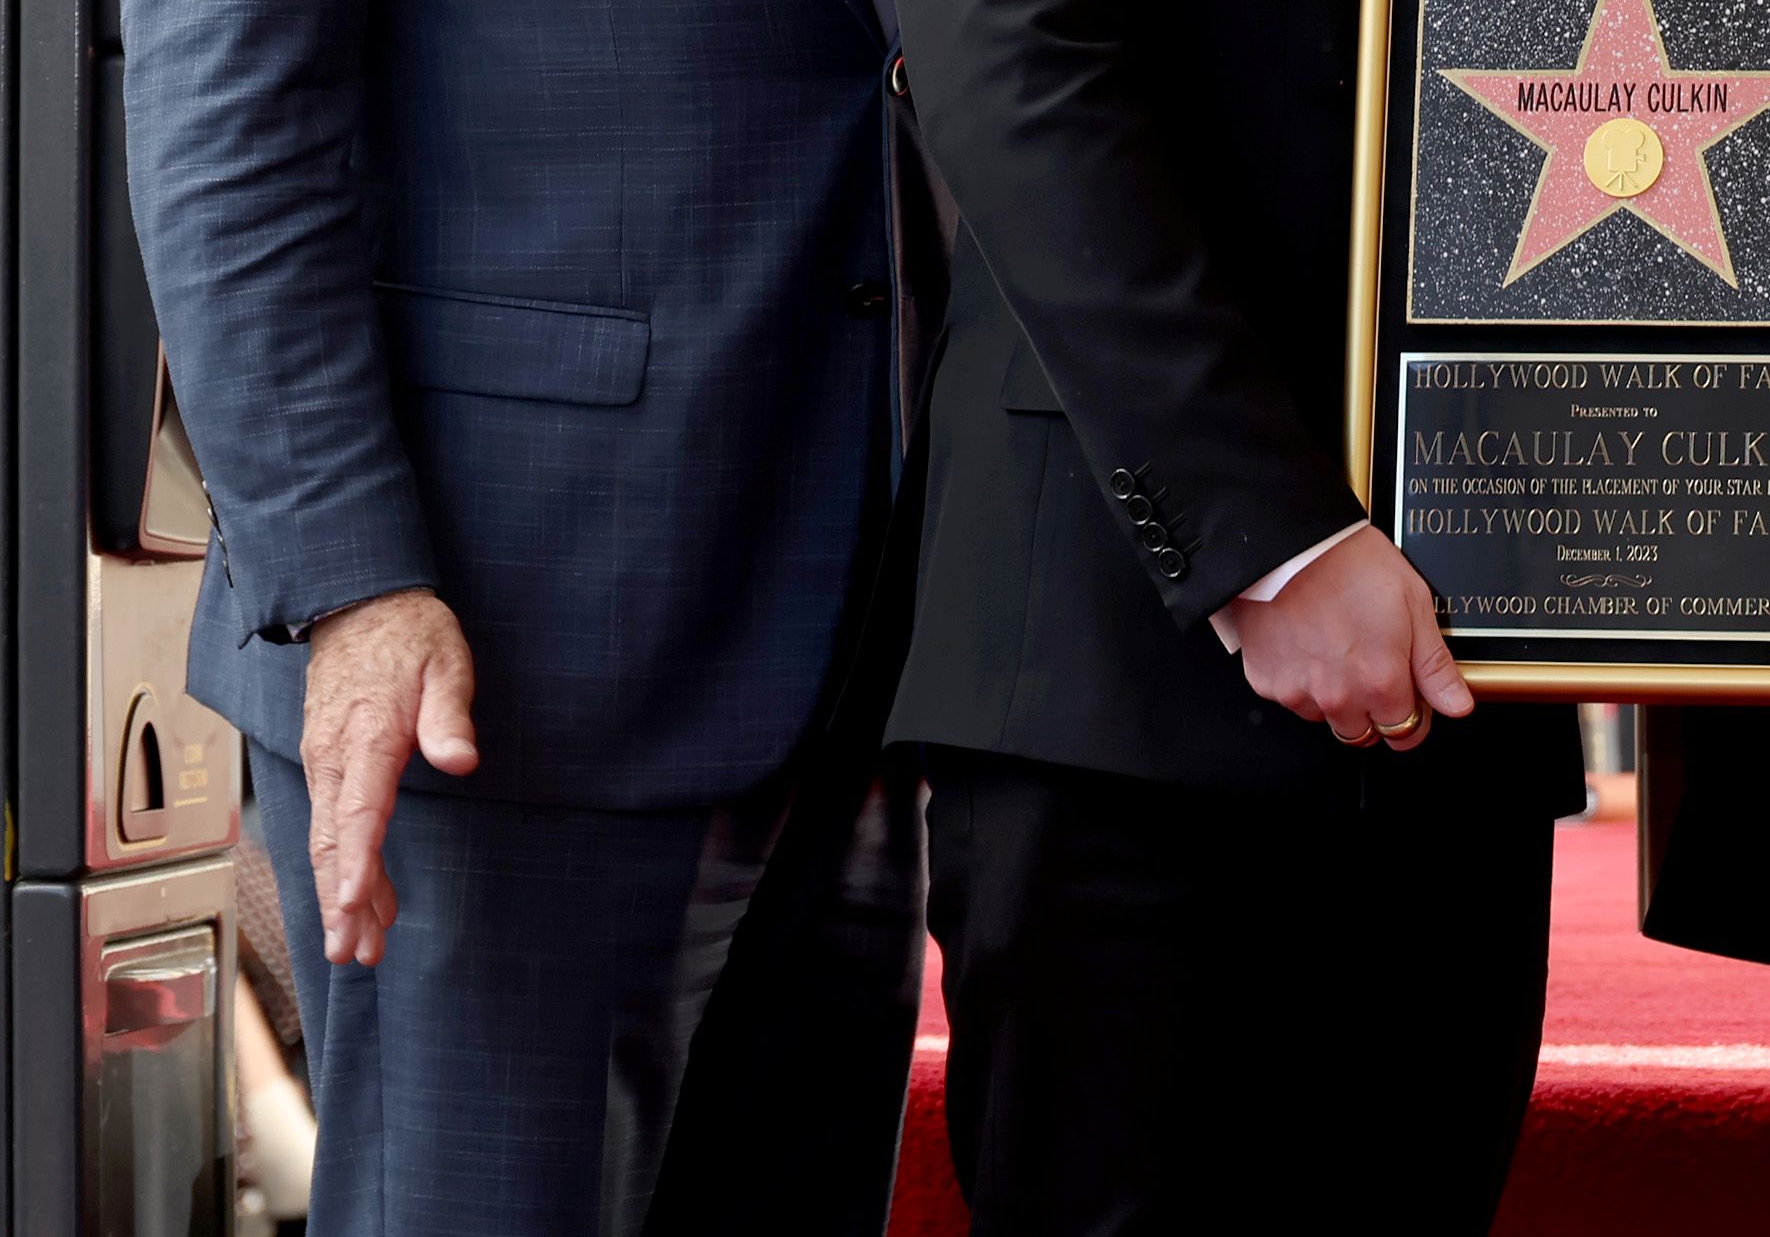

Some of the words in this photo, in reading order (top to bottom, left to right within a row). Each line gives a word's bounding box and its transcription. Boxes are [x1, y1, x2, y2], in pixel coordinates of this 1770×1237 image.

[1517, 82, 1637, 112] MACAULAY
[1647, 82, 1729, 113] CULKIN
[1414, 363, 1588, 389] HOLLYWOOD
[1600, 364, 1683, 390] WALK
[1693, 364, 1728, 390] OF
[1413, 430, 1646, 466] MACAULAY
[1409, 477, 1428, 496] ON
[1432, 477, 1458, 496] THE
[1461, 477, 1526, 496] OCCASION
[1530, 477, 1548, 496] OF
[1551, 477, 1578, 496] THE
[1581, 477, 1659, 496] PLACEMENT
[1661, 477, 1680, 496] OF
[1685, 477, 1724, 496] YOUR
[1726, 477, 1763, 496] STAR
[1408, 508, 1582, 535] HOLLYWOOD
[1592, 508, 1676, 535] WALK
[1686, 509, 1722, 536] OF
[1626, 545, 1659, 562] 2023
[1434, 595, 1537, 615] LLYWOOD
[1543, 595, 1639, 615] CHAMBER
[1646, 596, 1673, 616] OF
